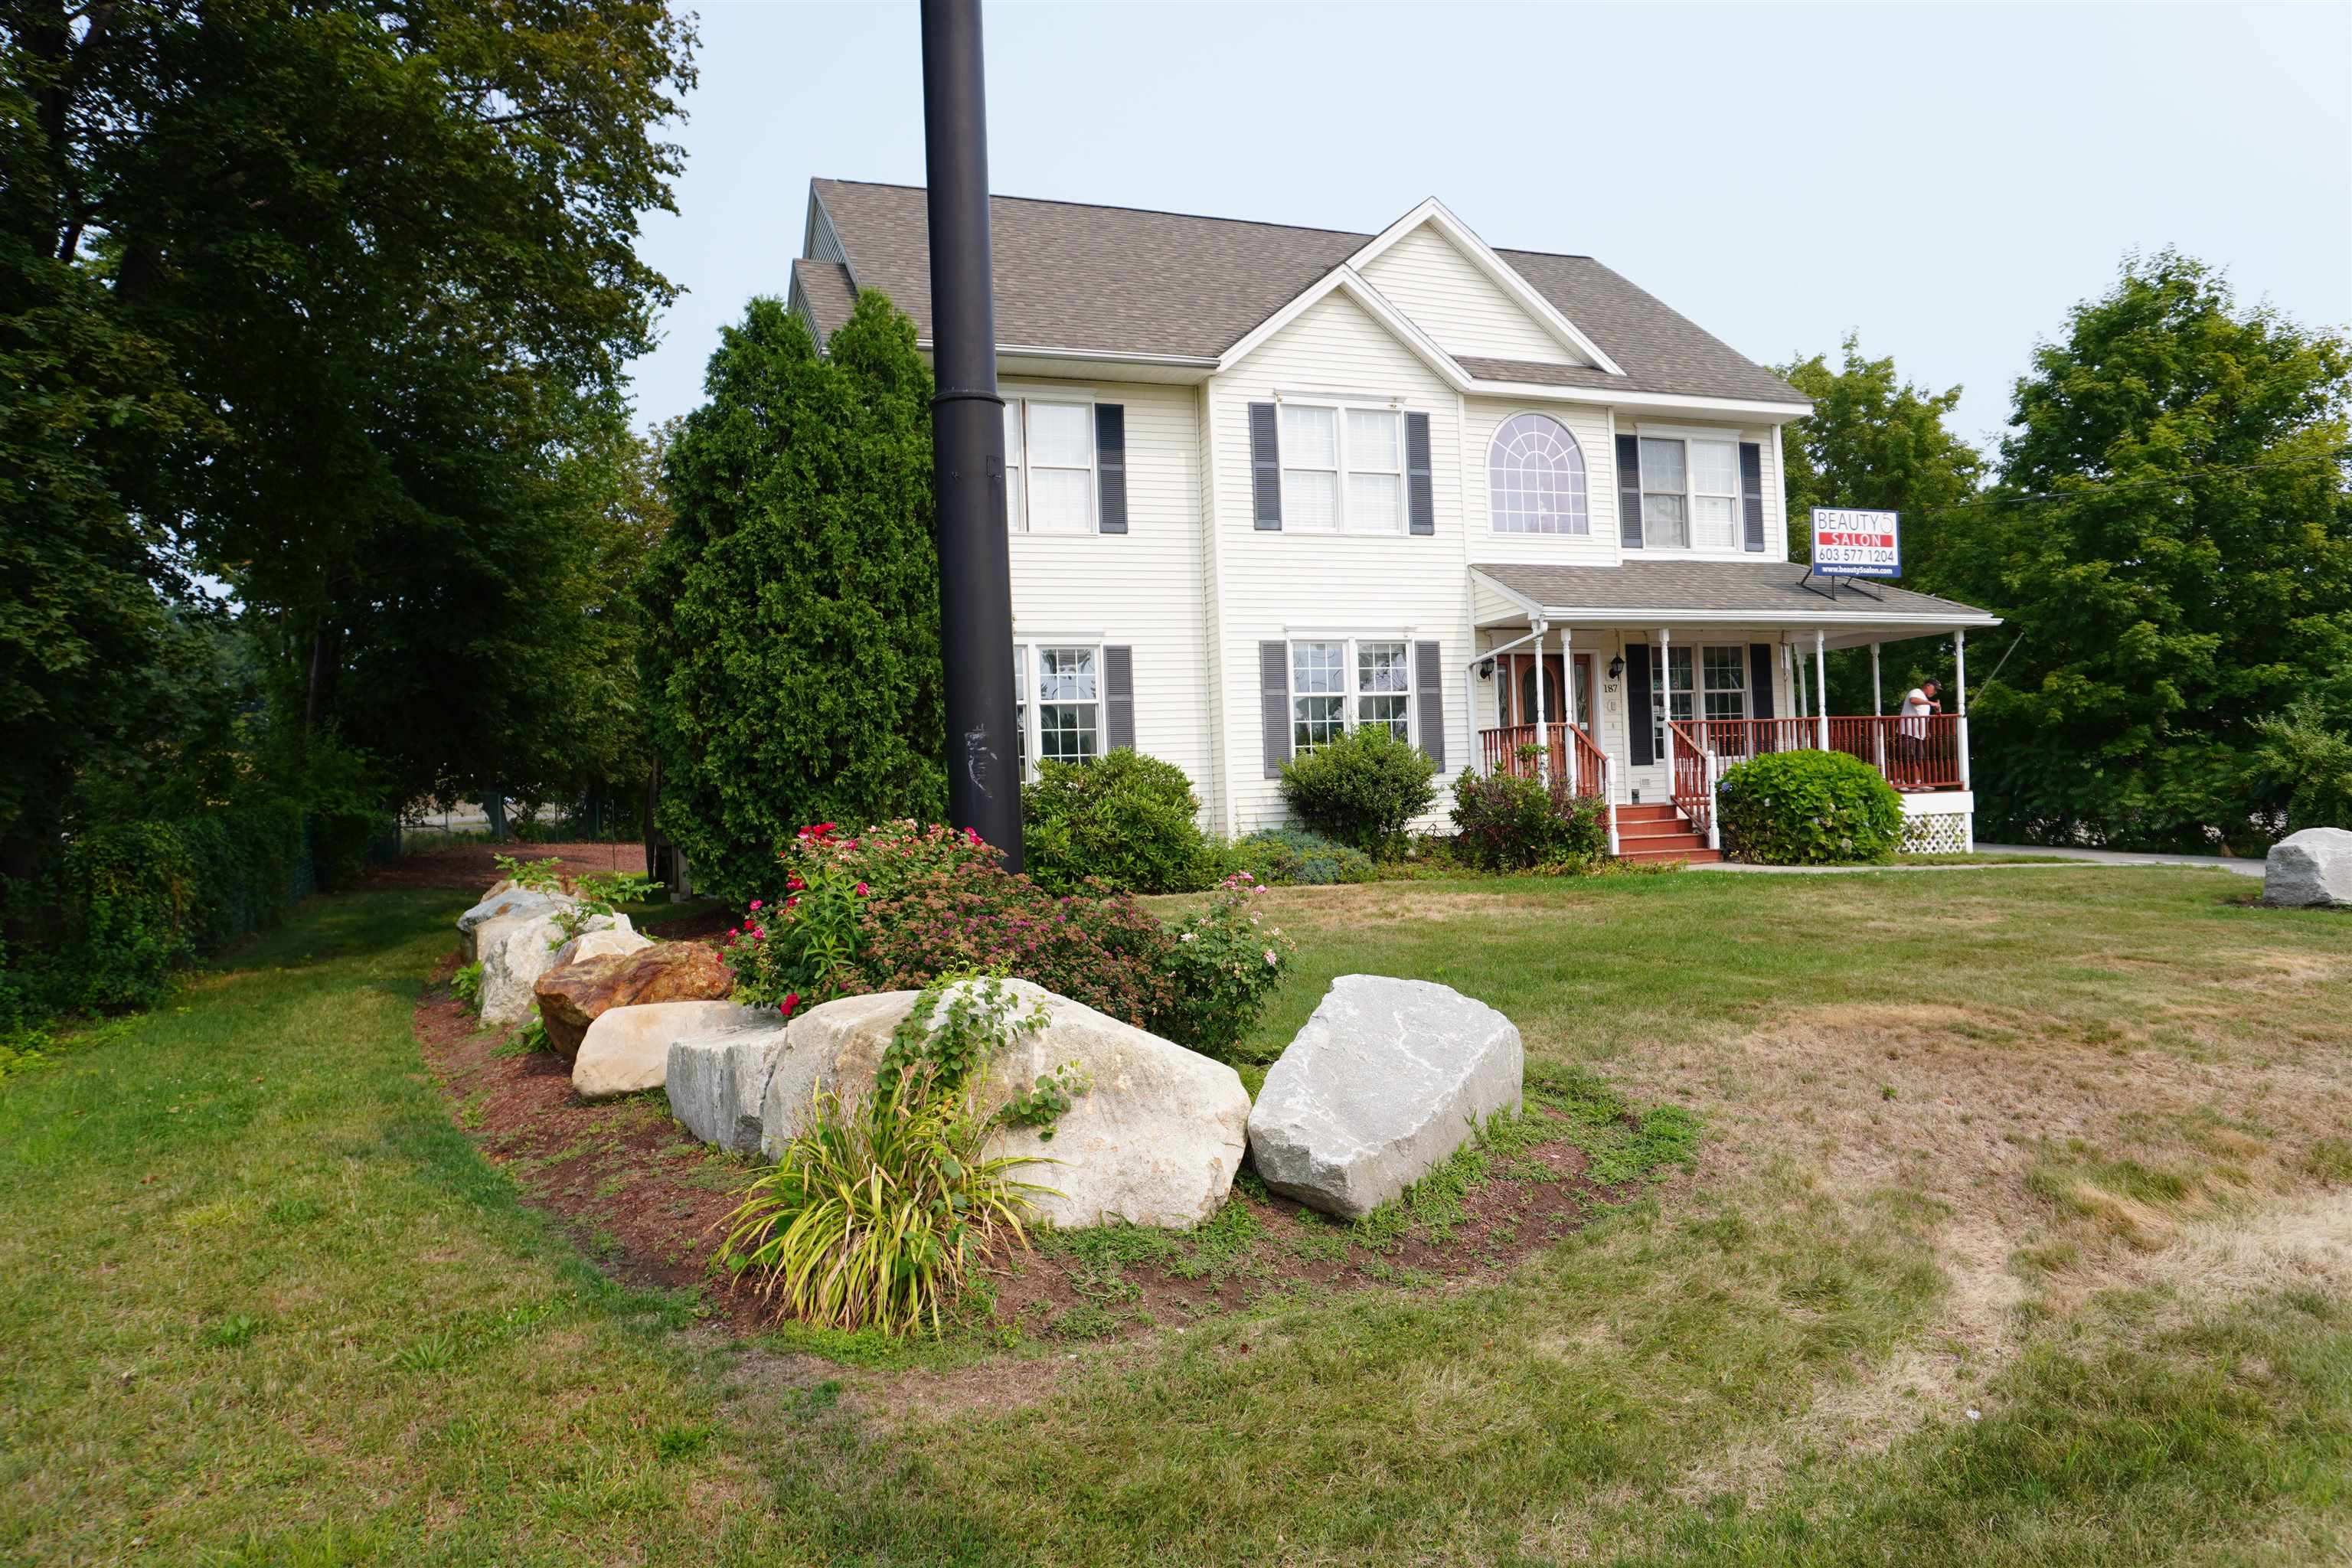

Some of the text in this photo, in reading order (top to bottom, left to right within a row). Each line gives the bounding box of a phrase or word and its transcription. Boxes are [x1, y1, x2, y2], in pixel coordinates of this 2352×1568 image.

[1832, 532, 1881, 547] SALON
[1819, 548, 1894, 563] 603 577 1204
[1604, 684, 1618, 693] 187
